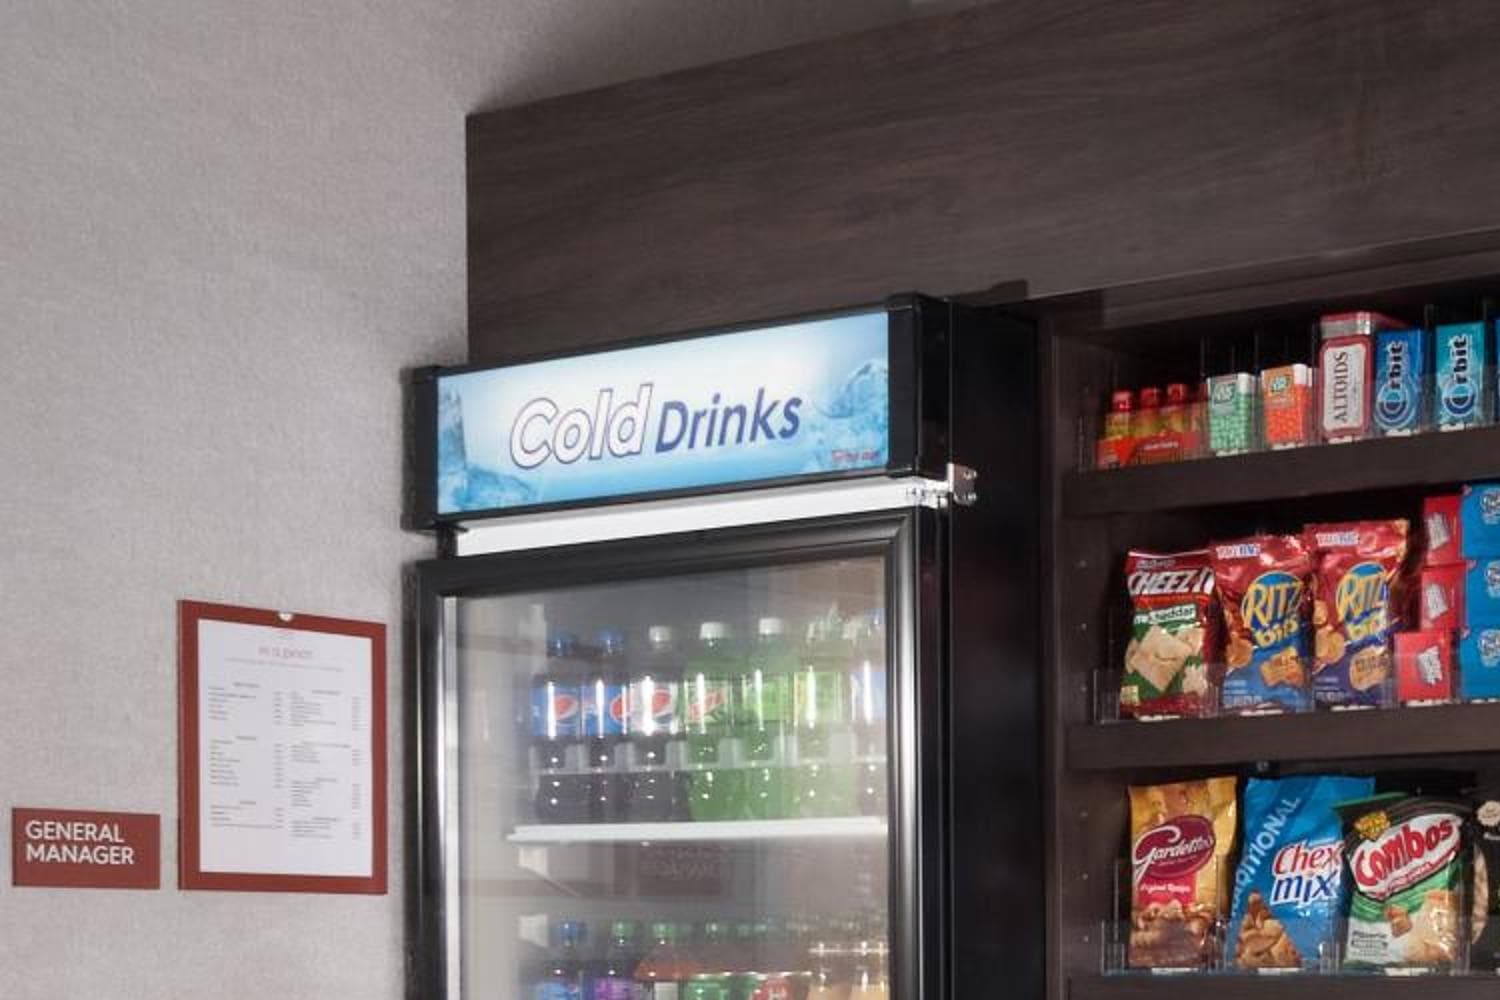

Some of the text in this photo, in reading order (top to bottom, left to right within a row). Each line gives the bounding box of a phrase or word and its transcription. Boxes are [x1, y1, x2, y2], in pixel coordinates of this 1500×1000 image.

[1333, 351, 1349, 423] ALTOIDS
[510, 383, 803, 470] Cold Drinks
[1127, 569, 1193, 595] CHEEZ
[1245, 579, 1304, 627] RITZ
[1340, 571, 1389, 621] RITZ
[25, 820, 125, 844] GENERAL
[25, 845, 135, 866] MANAGER
[1355, 818, 1455, 887] Combos
[1273, 842, 1345, 875] Chex
